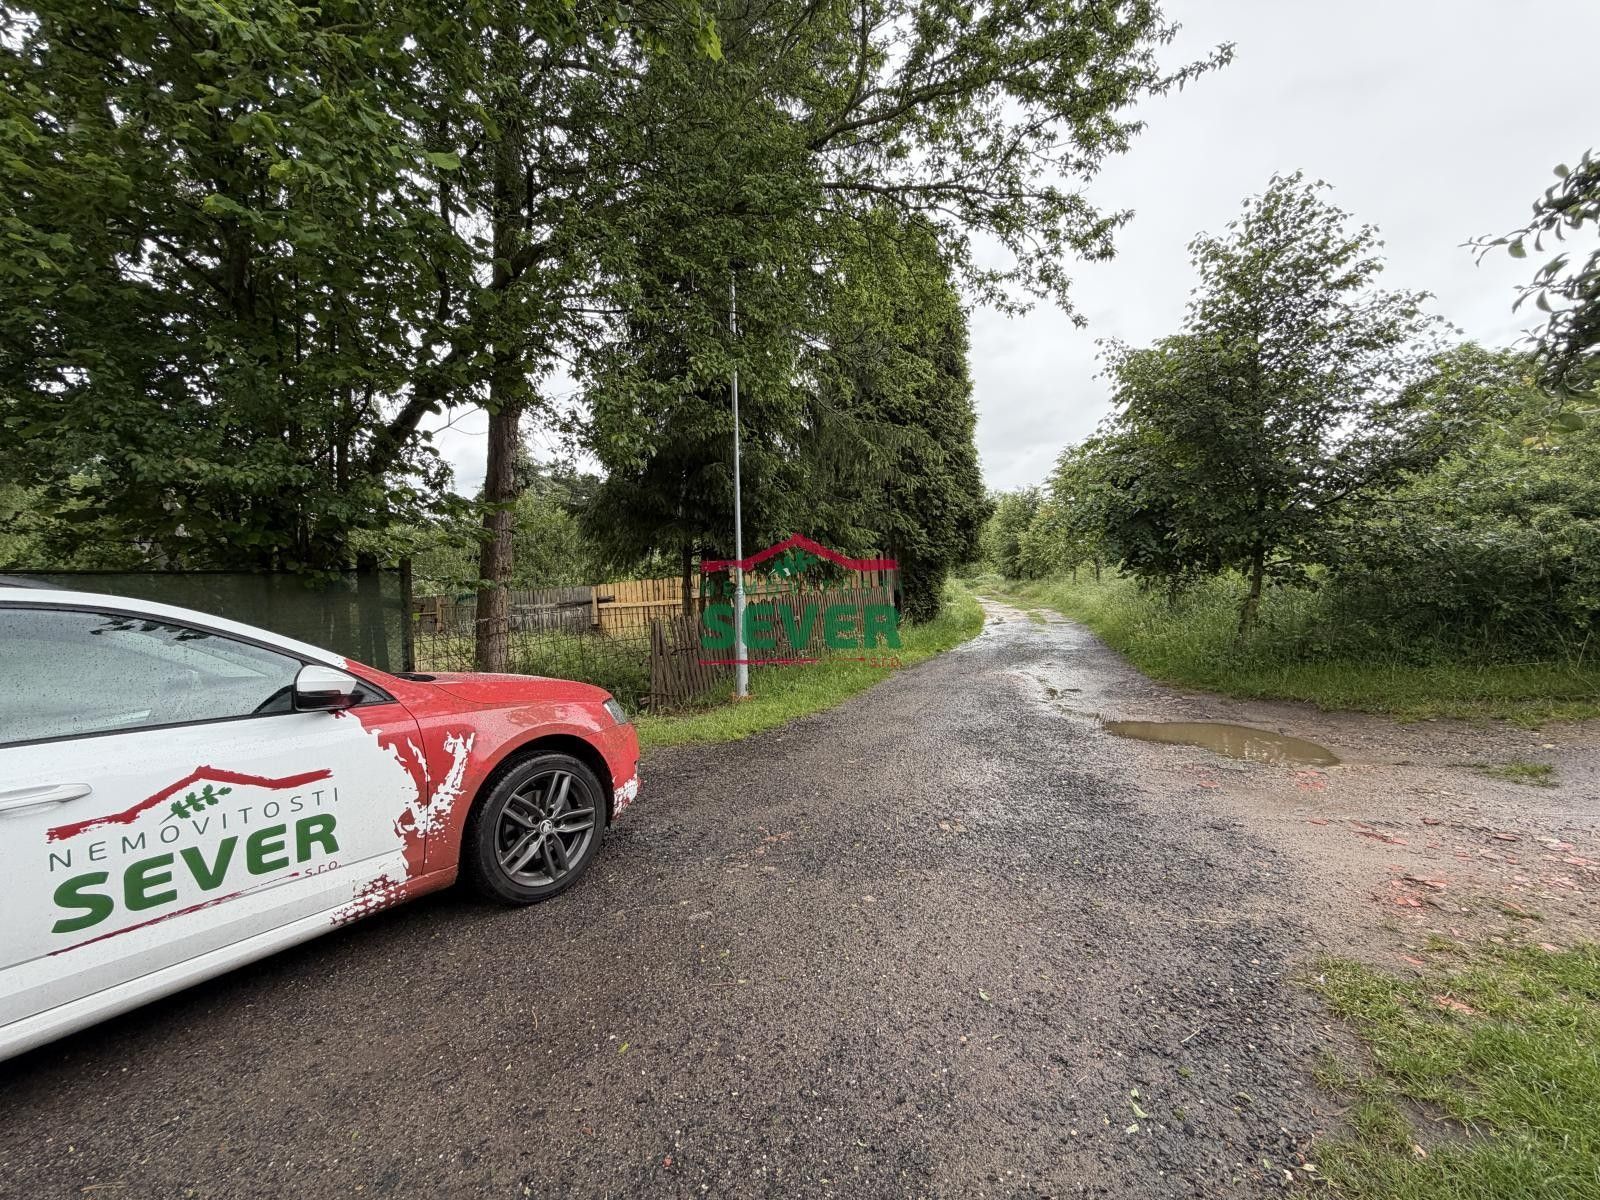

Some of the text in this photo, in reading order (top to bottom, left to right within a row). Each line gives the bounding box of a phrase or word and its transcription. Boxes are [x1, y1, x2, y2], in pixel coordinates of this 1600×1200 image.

[48, 787, 339, 871] NEMOVITOSTI
[305, 860, 341, 877] s.r.o.
[51, 813, 340, 933] SEVER
